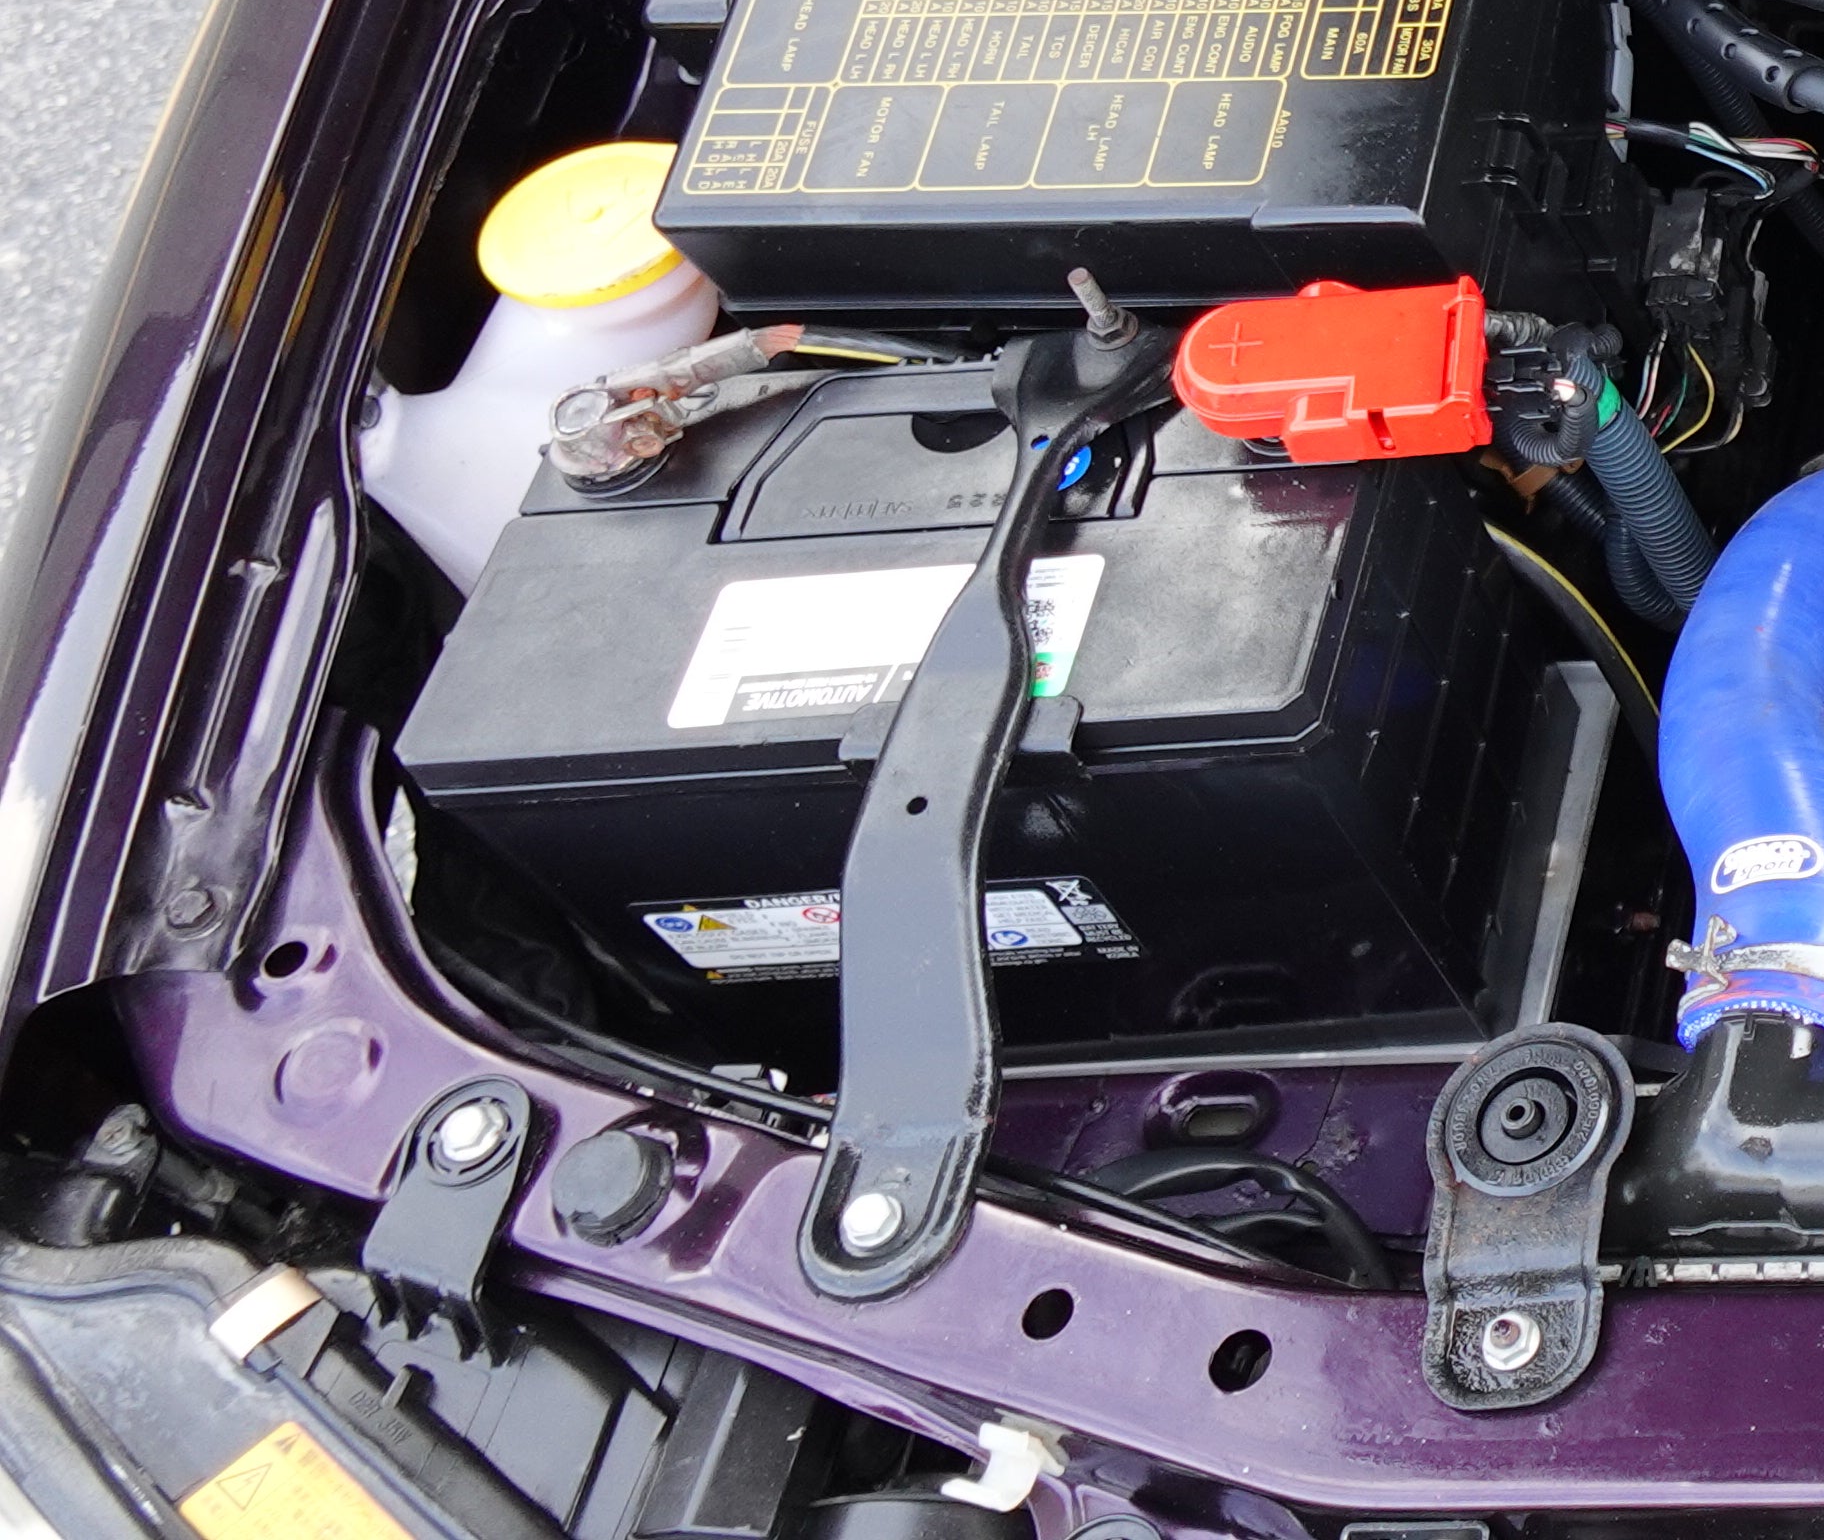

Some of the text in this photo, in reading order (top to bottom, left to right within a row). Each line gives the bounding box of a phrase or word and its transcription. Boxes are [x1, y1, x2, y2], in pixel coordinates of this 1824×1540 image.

[859, 20, 879, 49] HEAD
[892, 19, 912, 49] HEAD
[924, 20, 943, 49] HEAD
[957, 18, 976, 48] HEAD
[1182, 15, 1199, 39] ENG
[1239, 26, 1259, 63] AUDIO
[1269, 15, 1294, 73] FOG LAMP
[1321, 28, 1340, 60] MAIN
[1353, 32, 1368, 54] 60A
[781, 38, 800, 72] LAMP
[982, 30, 1004, 65] HORN
[1016, 35, 1035, 59] TAIL
[1048, 35, 1066, 59] TCS
[1078, 24, 1100, 69] DEICER
[1111, 28, 1132, 64] HICAS
[1141, 20, 1165, 72] AIR CON
[1204, 15, 1230, 75] ENG CONT
[1392, 28, 1413, 74] MOTOR FAN
[1419, 39, 1434, 61] 30A
[796, 120, 817, 155] FUSE
[855, 96, 893, 178] MOTOR FAN
[974, 101, 1004, 170] TAIL LAMP
[1086, 124, 1101, 141] LH
[1093, 94, 1125, 172] HEAD LAMP
[1203, 93, 1233, 170] HEAD LAMP
[1271, 110, 1292, 148] AA010
[742, 683, 873, 712] AUTOMOTIVE
